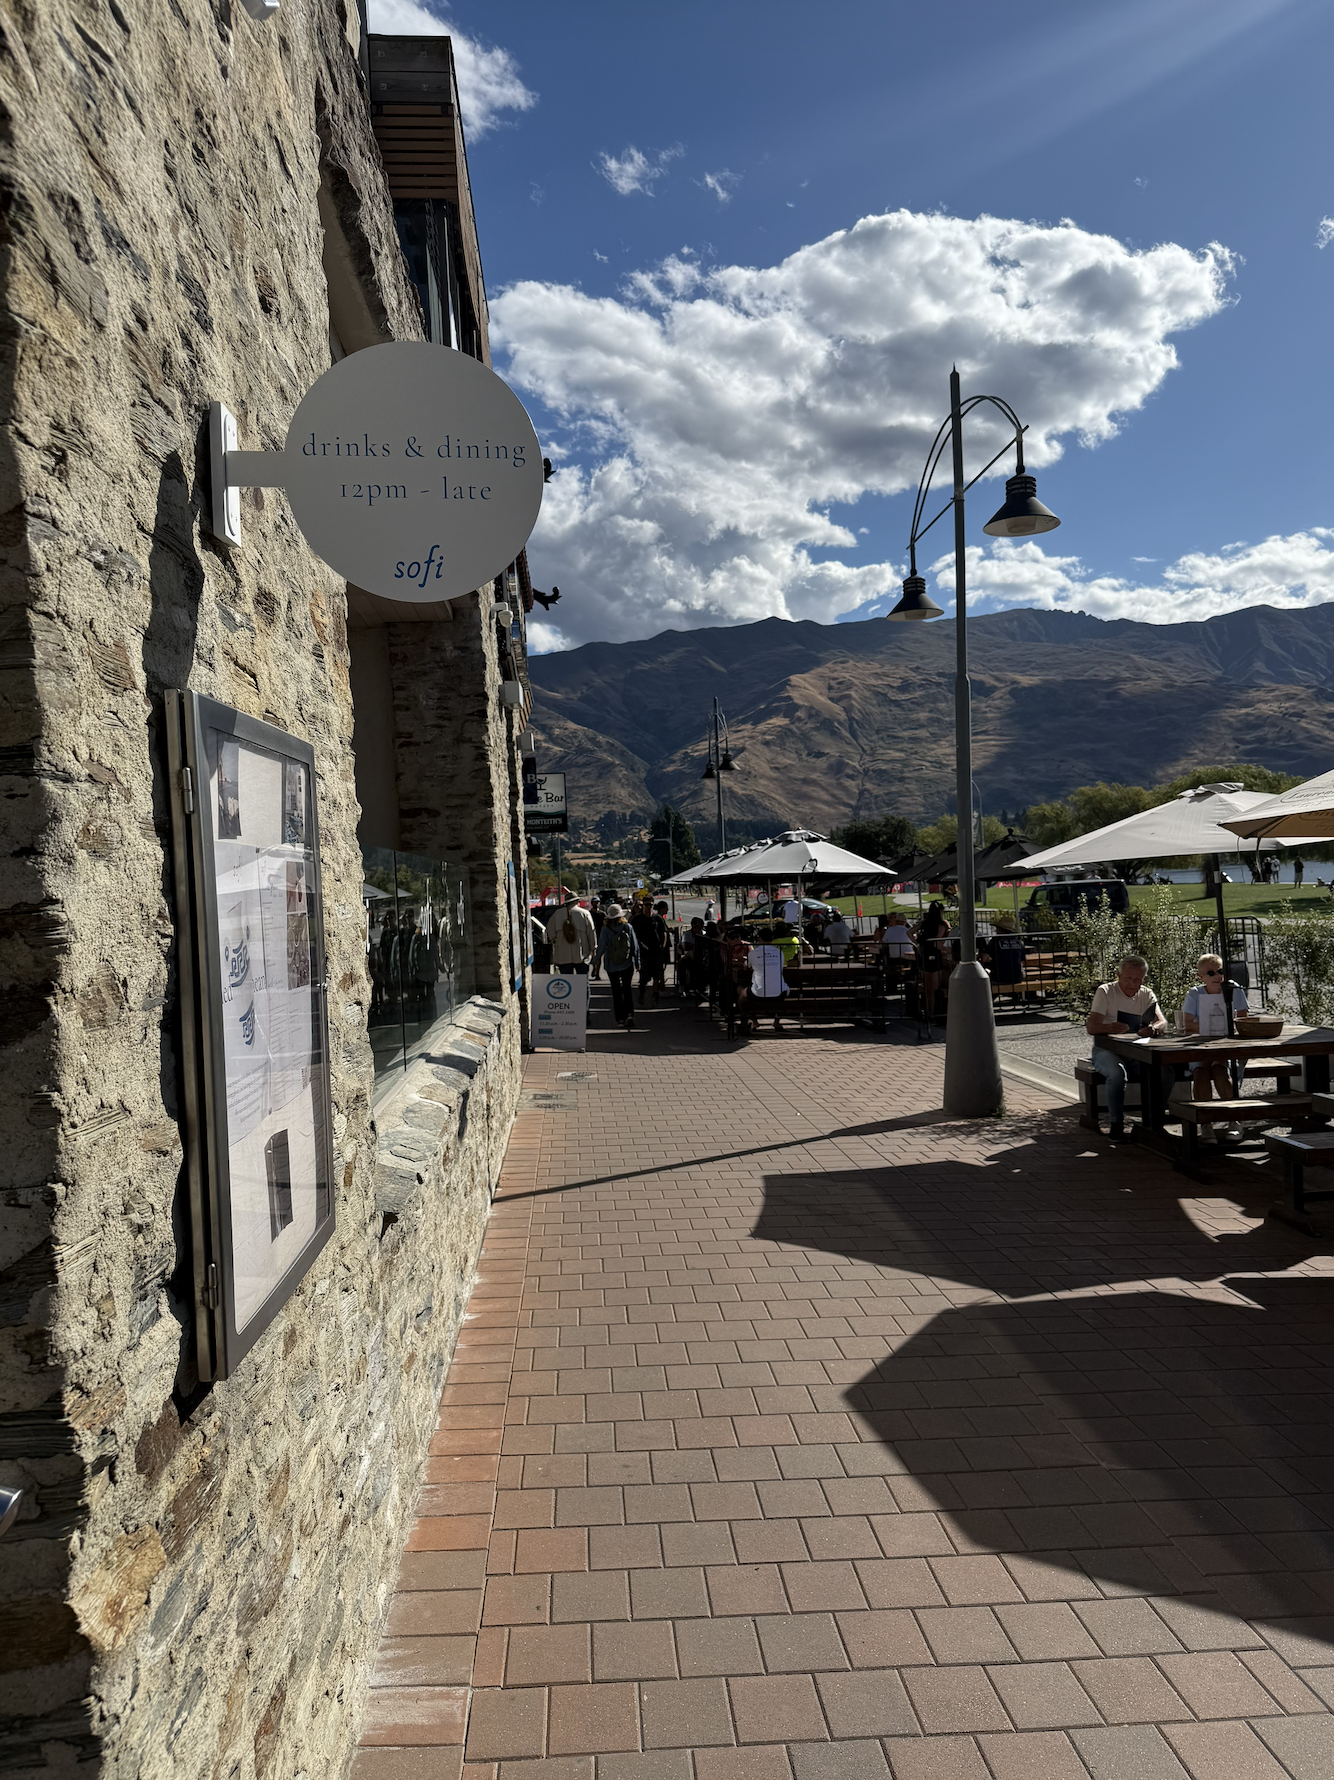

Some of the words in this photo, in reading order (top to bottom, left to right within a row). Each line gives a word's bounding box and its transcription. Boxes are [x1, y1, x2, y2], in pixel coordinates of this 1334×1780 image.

[302, 433, 391, 457] drinks
[405, 436, 425, 458] &
[437, 435, 526, 467] dining
[340, 483, 407, 506] 12pm
[443, 476, 492, 500] late
[394, 545, 444, 588] sofi
[544, 792, 564, 803] Bar
